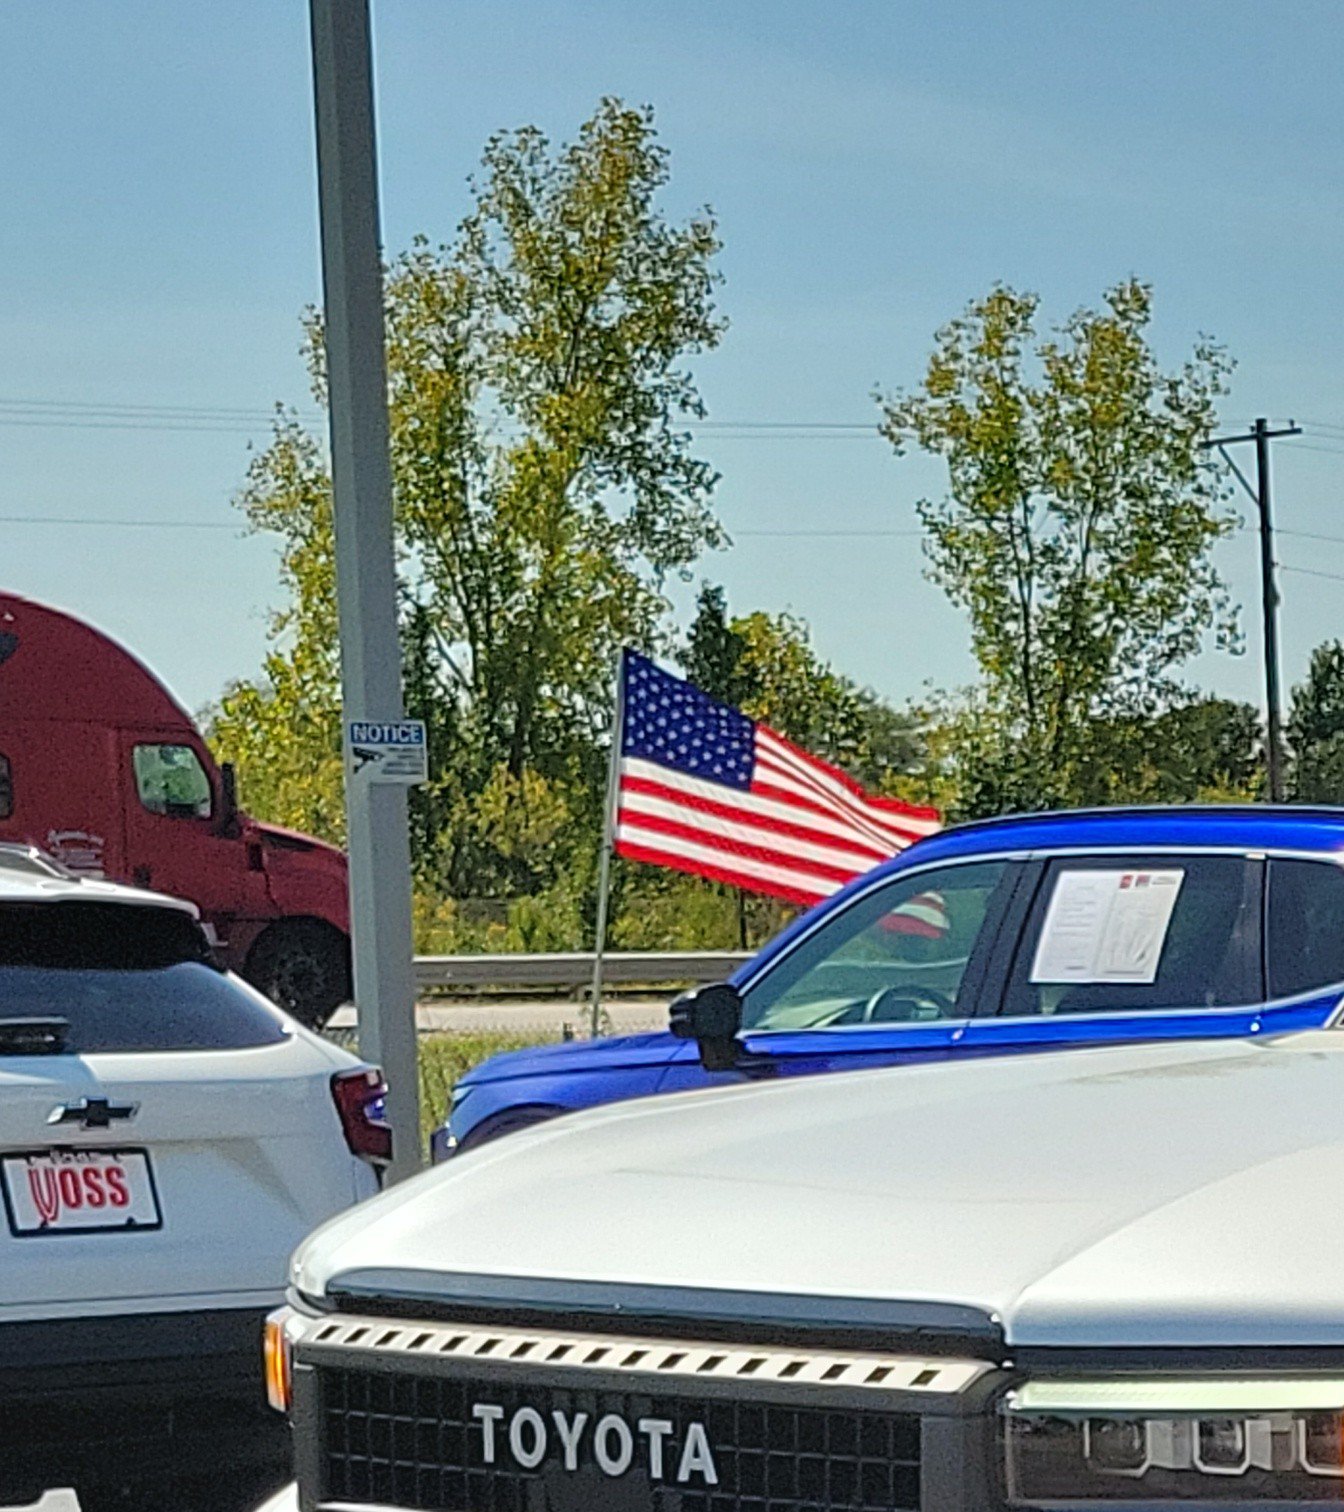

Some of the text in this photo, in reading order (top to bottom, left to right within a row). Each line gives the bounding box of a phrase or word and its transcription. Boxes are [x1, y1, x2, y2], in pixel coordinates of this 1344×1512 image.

[353, 724, 421, 742] NOTICE
[27, 1166, 130, 1222] VOSS
[472, 1403, 720, 1486] TOYOTA
